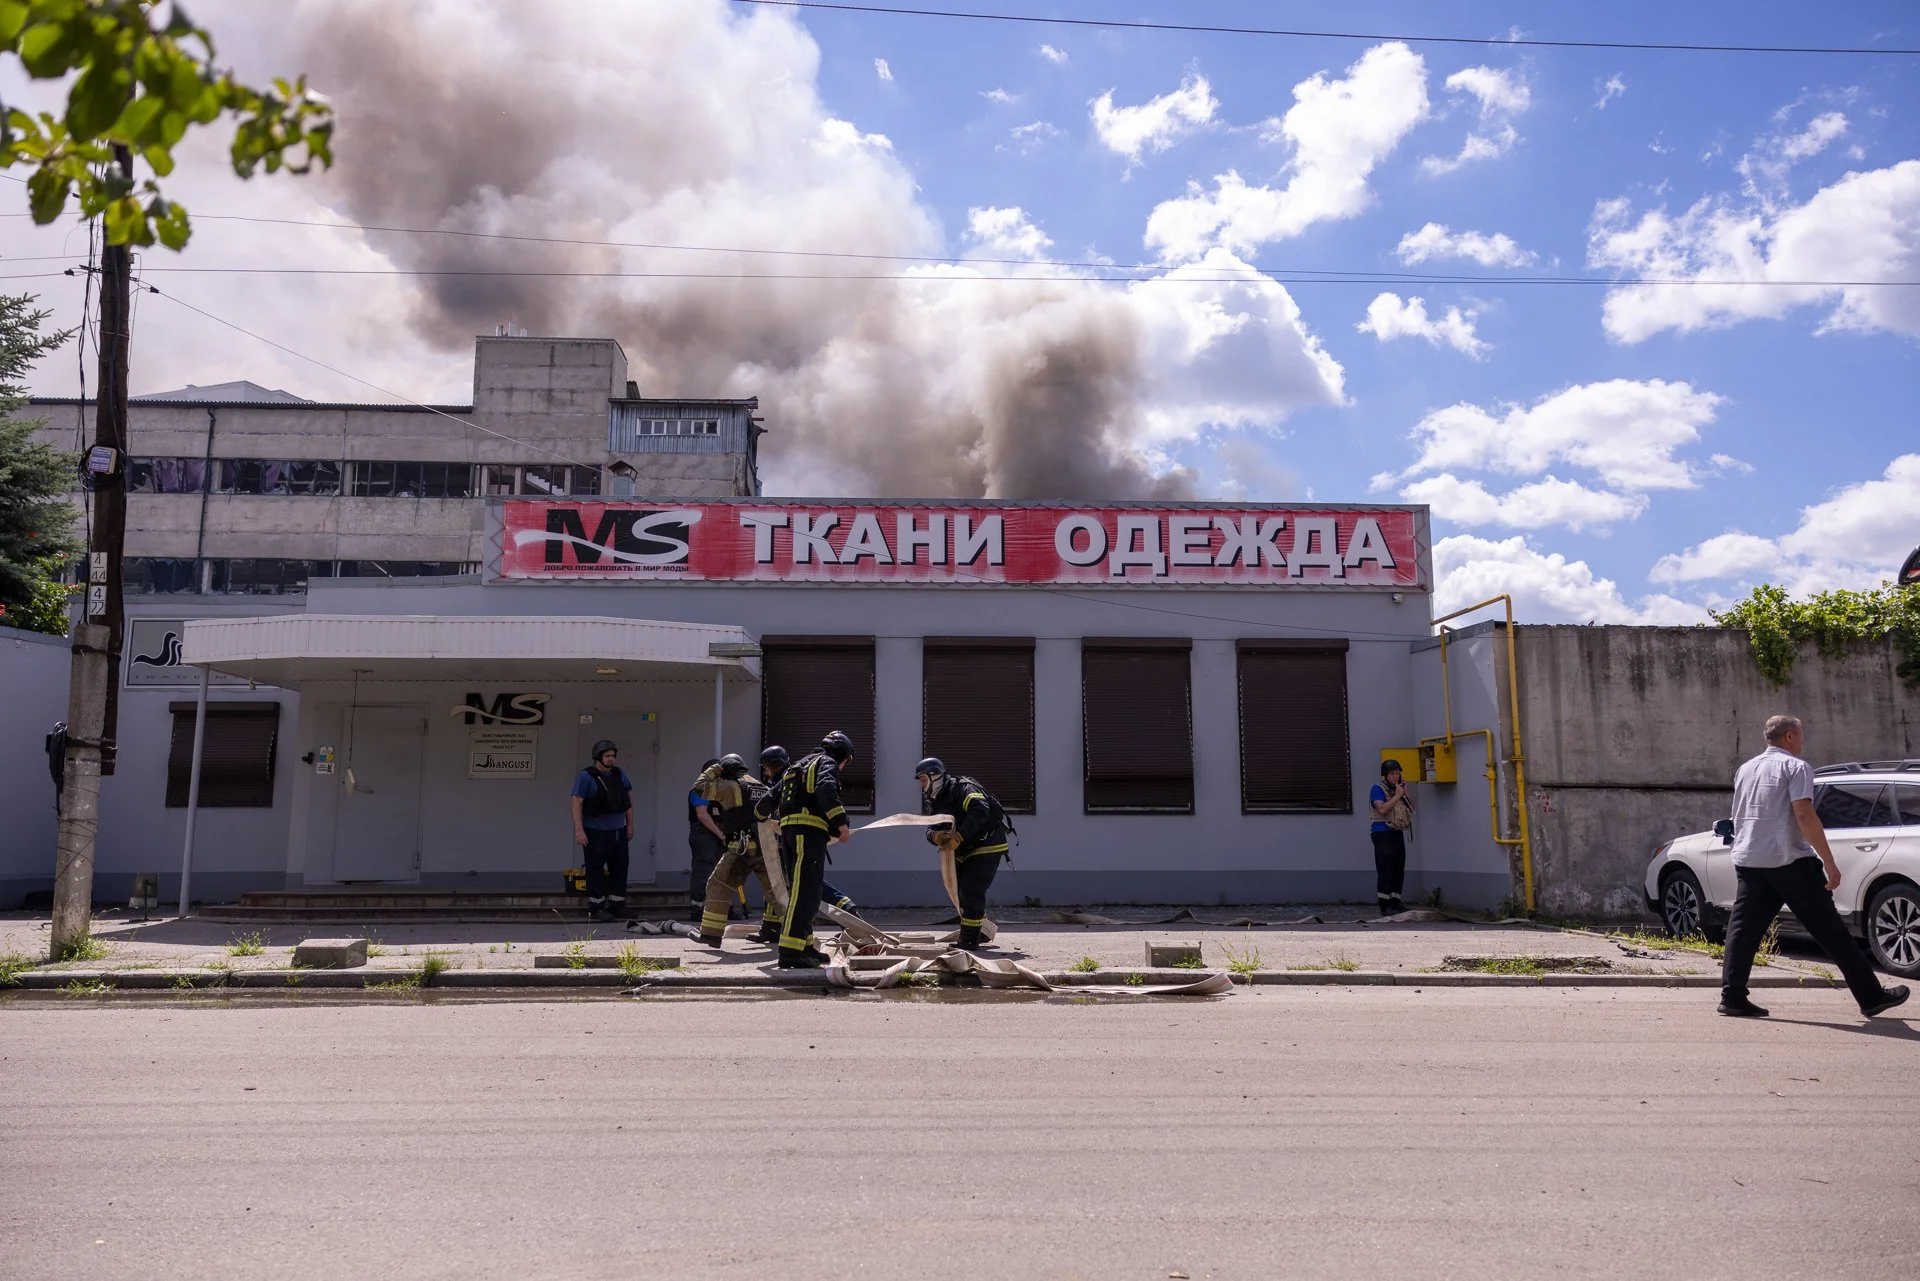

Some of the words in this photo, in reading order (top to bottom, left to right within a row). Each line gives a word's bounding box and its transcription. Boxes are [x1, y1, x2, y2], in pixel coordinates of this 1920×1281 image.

[514, 508, 703, 565] MS
[740, 513, 1004, 566] ТКАНИ
[1054, 514, 1397, 578] ОДЕЖДА
[662, 565, 689, 573] МОДЫ
[450, 693, 553, 725] MS
